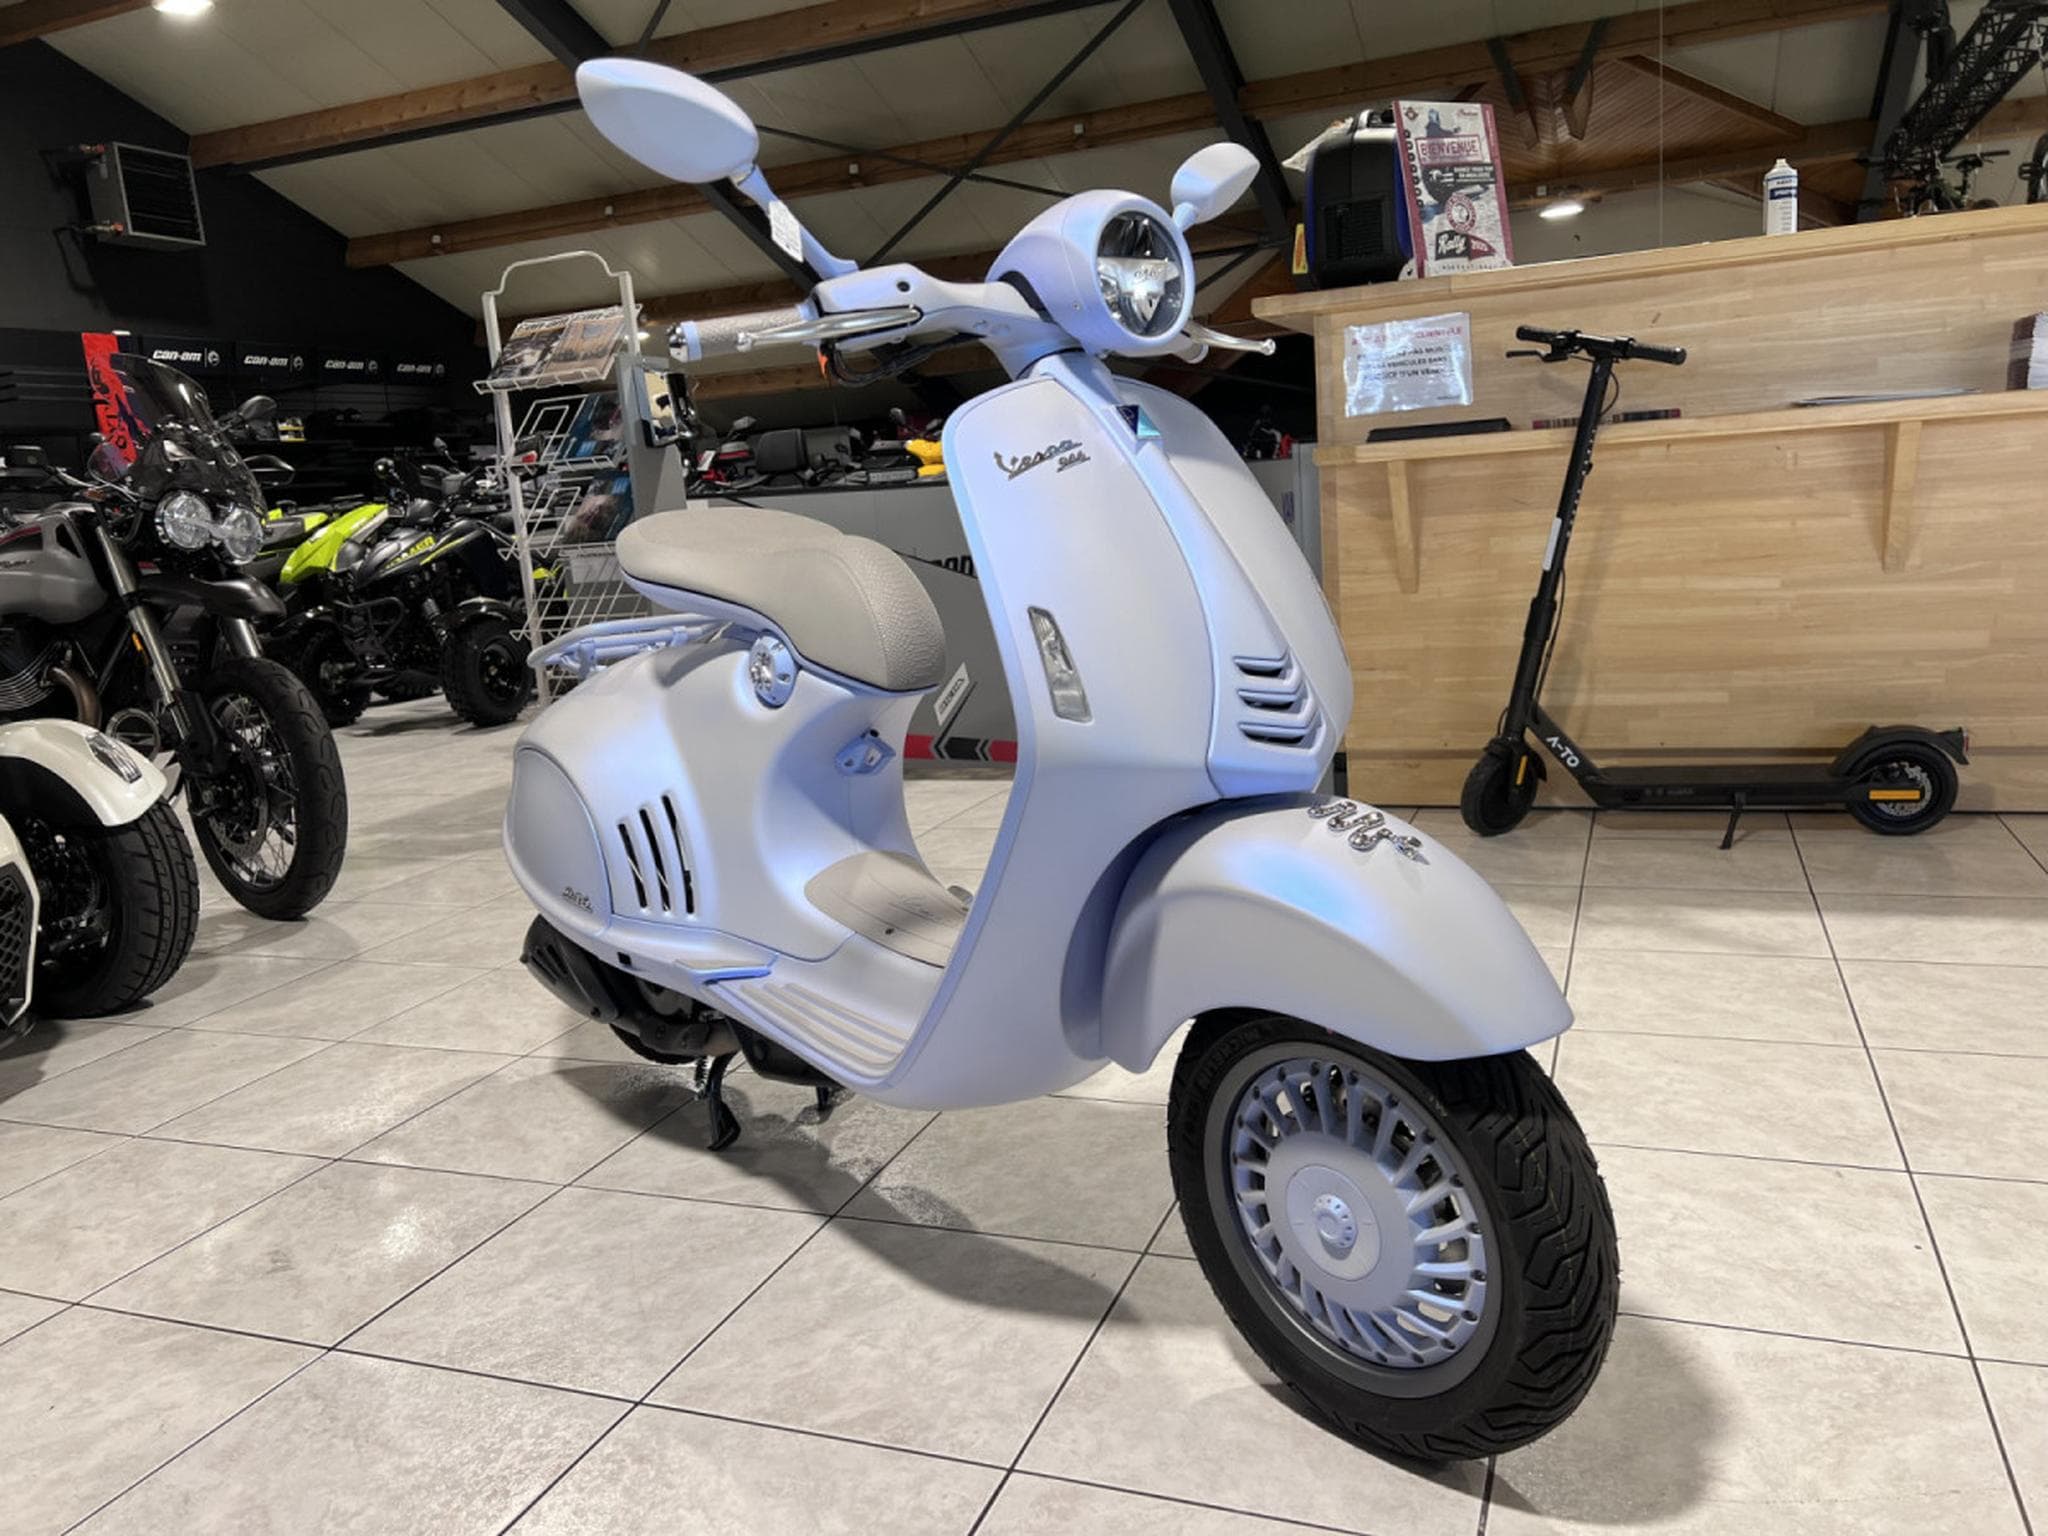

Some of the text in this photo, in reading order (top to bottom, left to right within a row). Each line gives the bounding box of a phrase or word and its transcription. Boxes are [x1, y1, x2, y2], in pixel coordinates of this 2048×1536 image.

[1419, 139, 1479, 157] BIENVENUE
[152, 350, 202, 362] can-am
[244, 355, 289, 366] can-am
[324, 359, 364, 370] can-am
[993, 439, 1083, 481] Vespa
